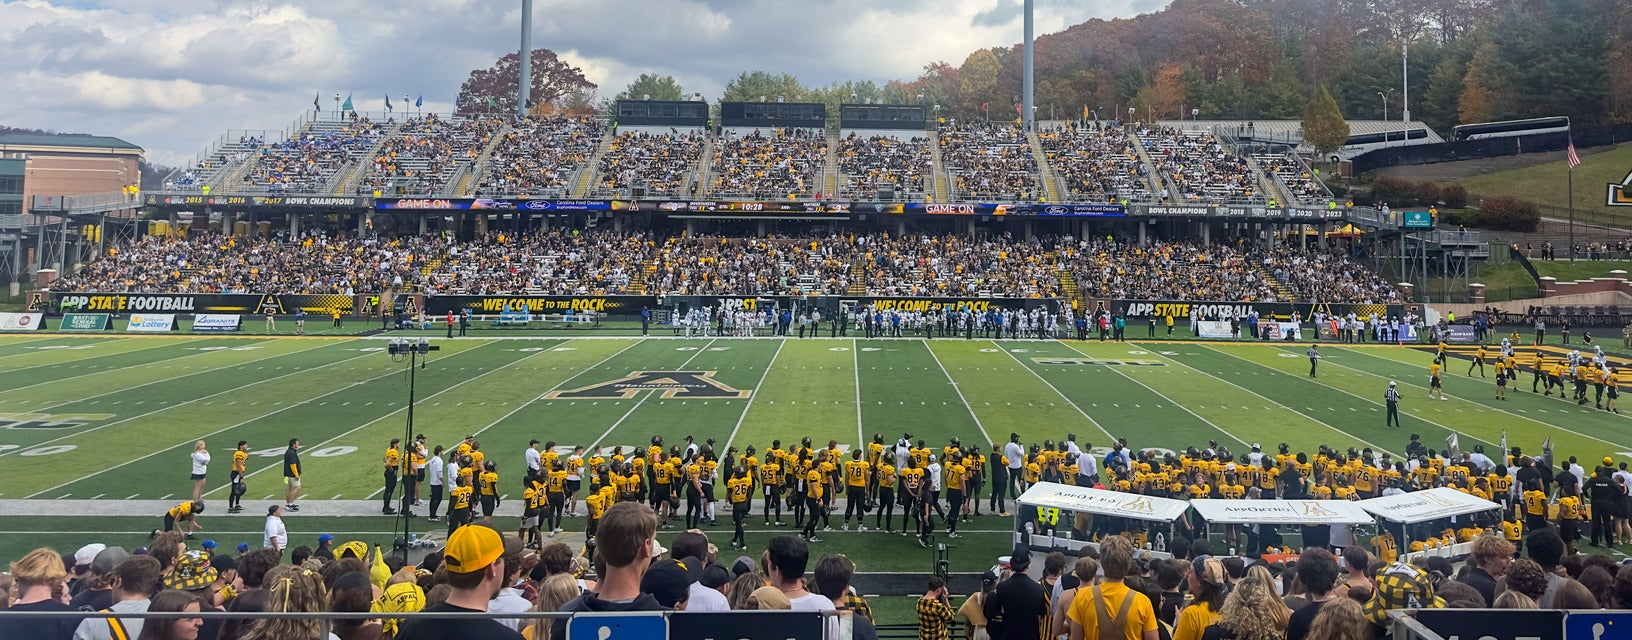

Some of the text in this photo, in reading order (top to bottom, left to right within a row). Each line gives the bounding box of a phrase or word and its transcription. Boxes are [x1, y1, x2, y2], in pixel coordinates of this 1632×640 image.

[310, 198, 355, 206] CHAMPIONS
[398, 199, 450, 209] GAME ON
[742, 203, 763, 211] 10:28
[925, 205, 974, 214] GAME ON
[128, 296, 195, 311] FOOTBALL
[545, 301, 555, 309] TO
[556, 301, 570, 309] THE
[571, 299, 606, 311] ROCK
[1127, 303, 1154, 317] APP
[1154, 303, 1190, 317] STATE
[142, 320, 169, 329] Lottery
[657, 469, 665, 479] 18
[763, 469, 773, 480] 25
[795, 465, 806, 475] 22
[851, 466, 862, 477] 78
[946, 469, 955, 480] 77
[908, 474, 919, 484] 89
[1242, 471, 1252, 481] 41
[1357, 469, 1369, 482] 76
[549, 477, 558, 488] 14
[1496, 480, 1507, 490] 10
[734, 485, 746, 496] 26
[1528, 497, 1534, 507] 4
[1513, 527, 1520, 538] 9
